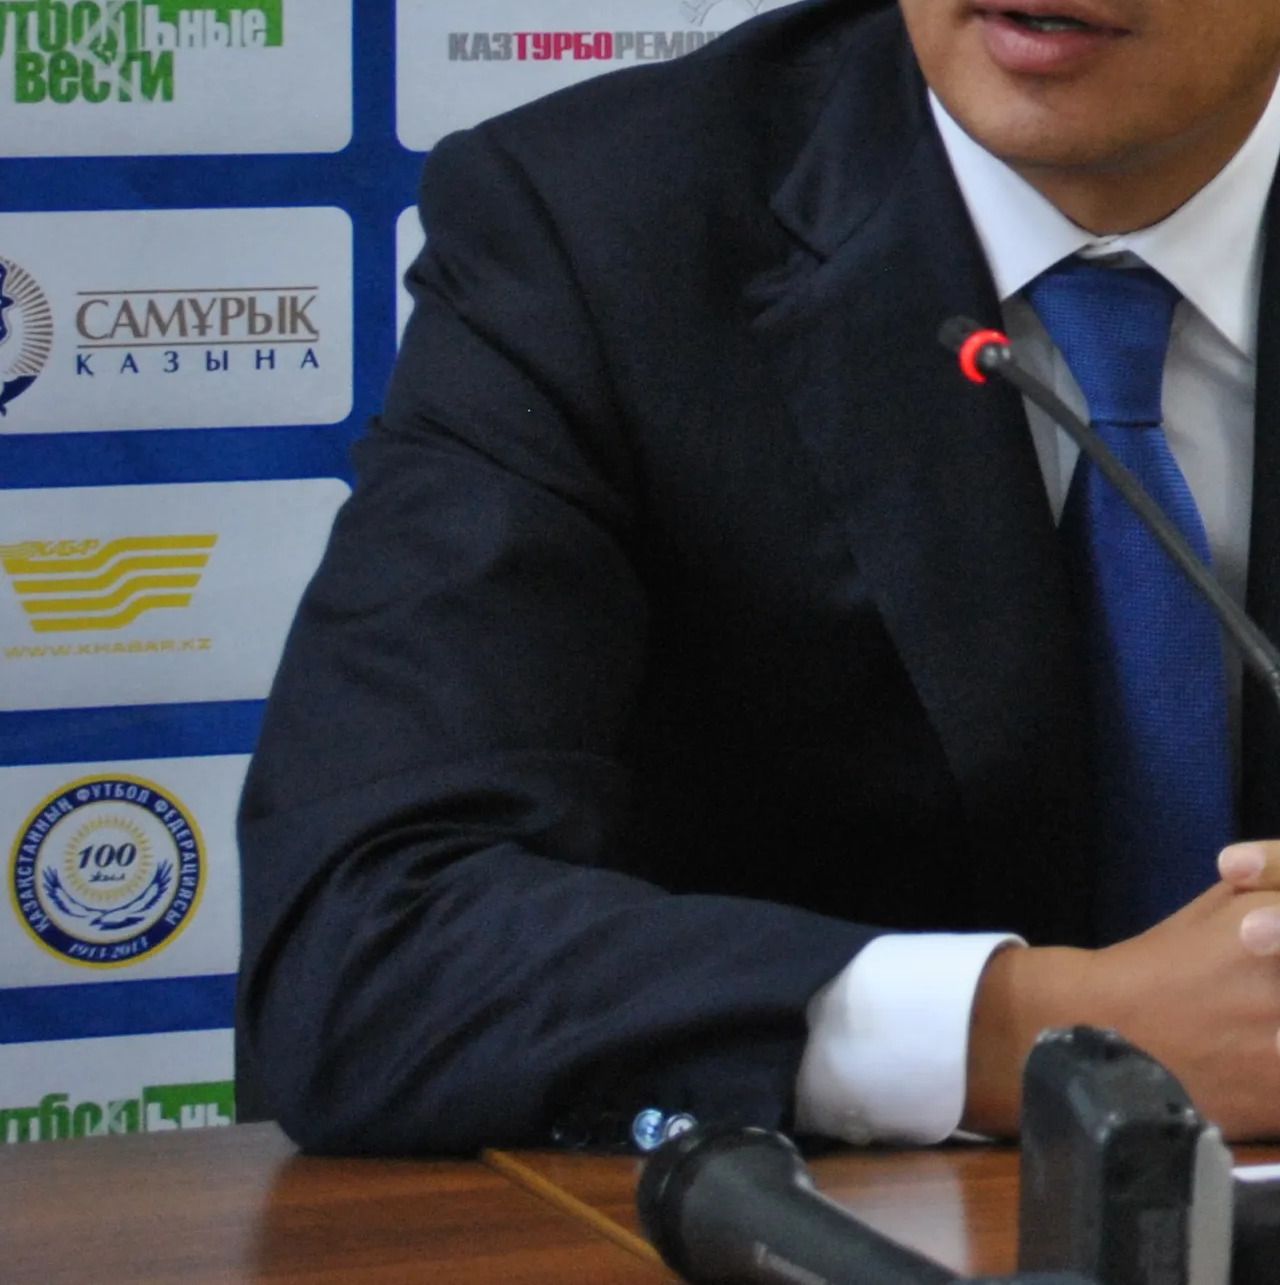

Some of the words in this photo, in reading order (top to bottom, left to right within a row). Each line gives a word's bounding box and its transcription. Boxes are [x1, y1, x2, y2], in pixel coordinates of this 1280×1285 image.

[76, 347, 320, 376] КАЗЫНА
[76, 782, 150, 803] ФУТБОЛ
[78, 842, 137, 869] 100
